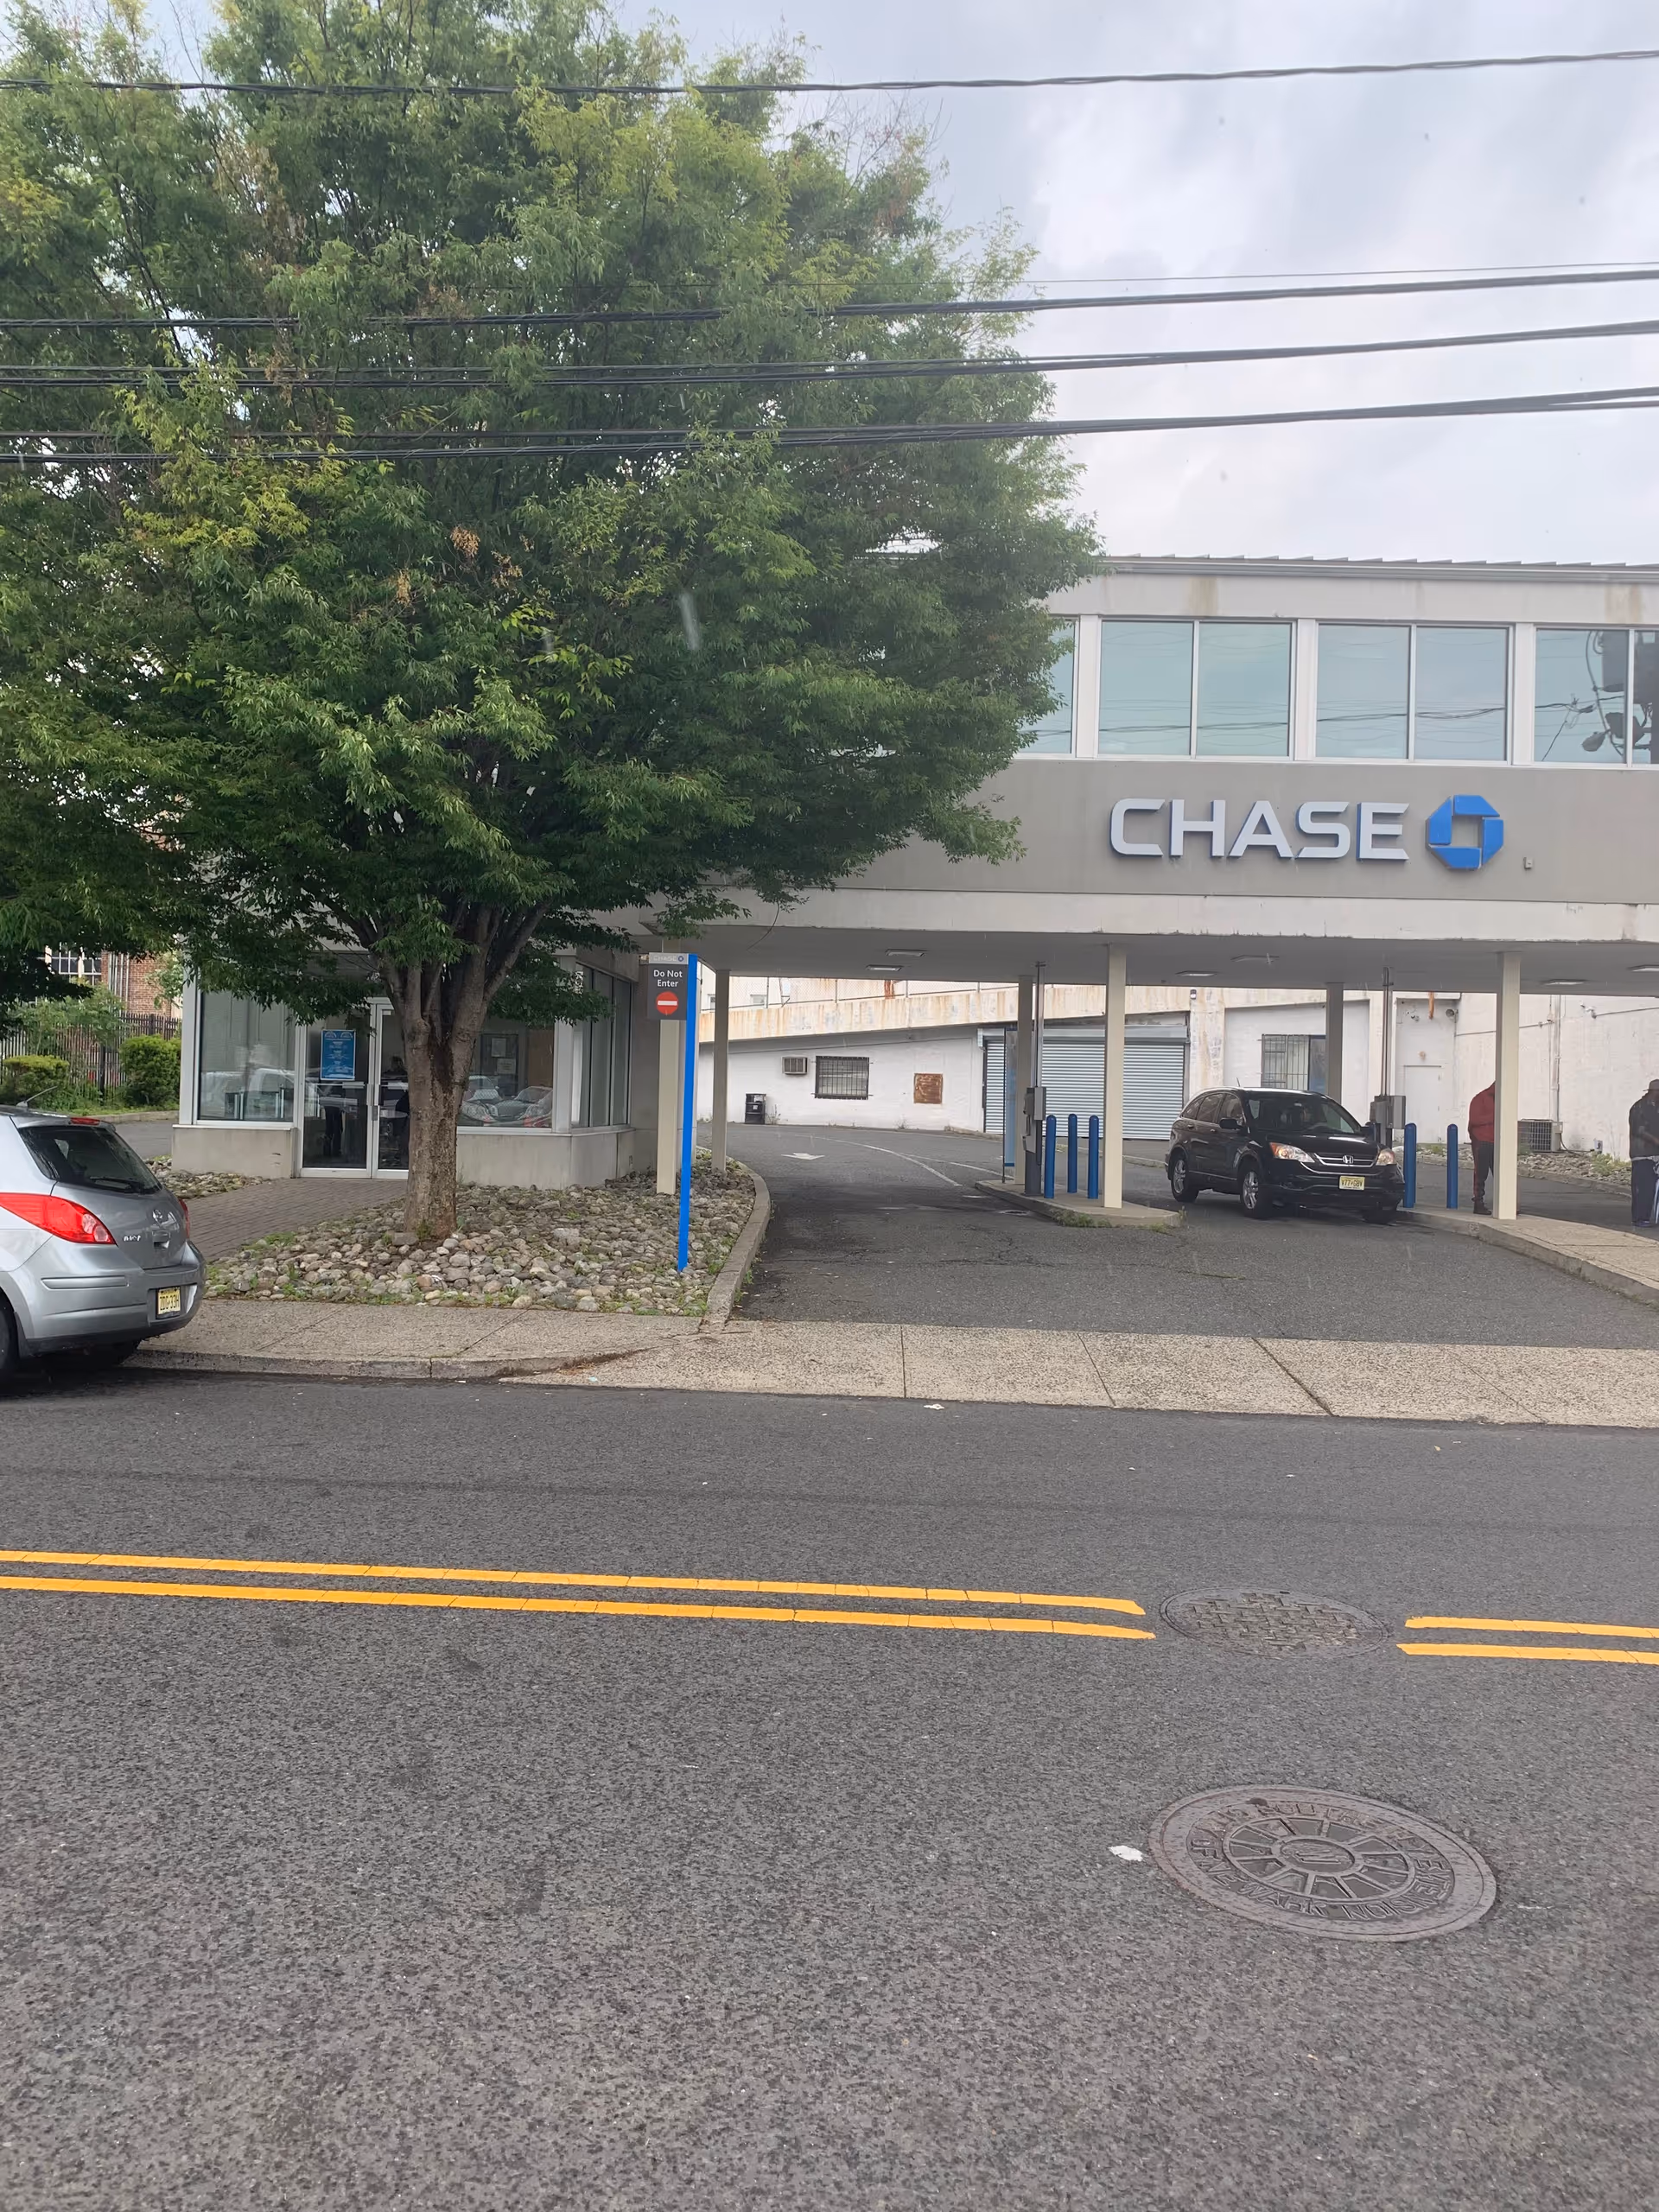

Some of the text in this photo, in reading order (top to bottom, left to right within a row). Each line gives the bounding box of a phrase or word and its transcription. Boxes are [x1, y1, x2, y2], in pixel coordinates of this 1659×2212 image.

[1109, 798, 1410, 860] CHASE
[657, 979, 679, 988] Enter
[667, 969, 683, 978] Not
[1198, 1860, 1328, 1917] NEWARK
[1341, 1858, 1452, 1921] EXTENSION
